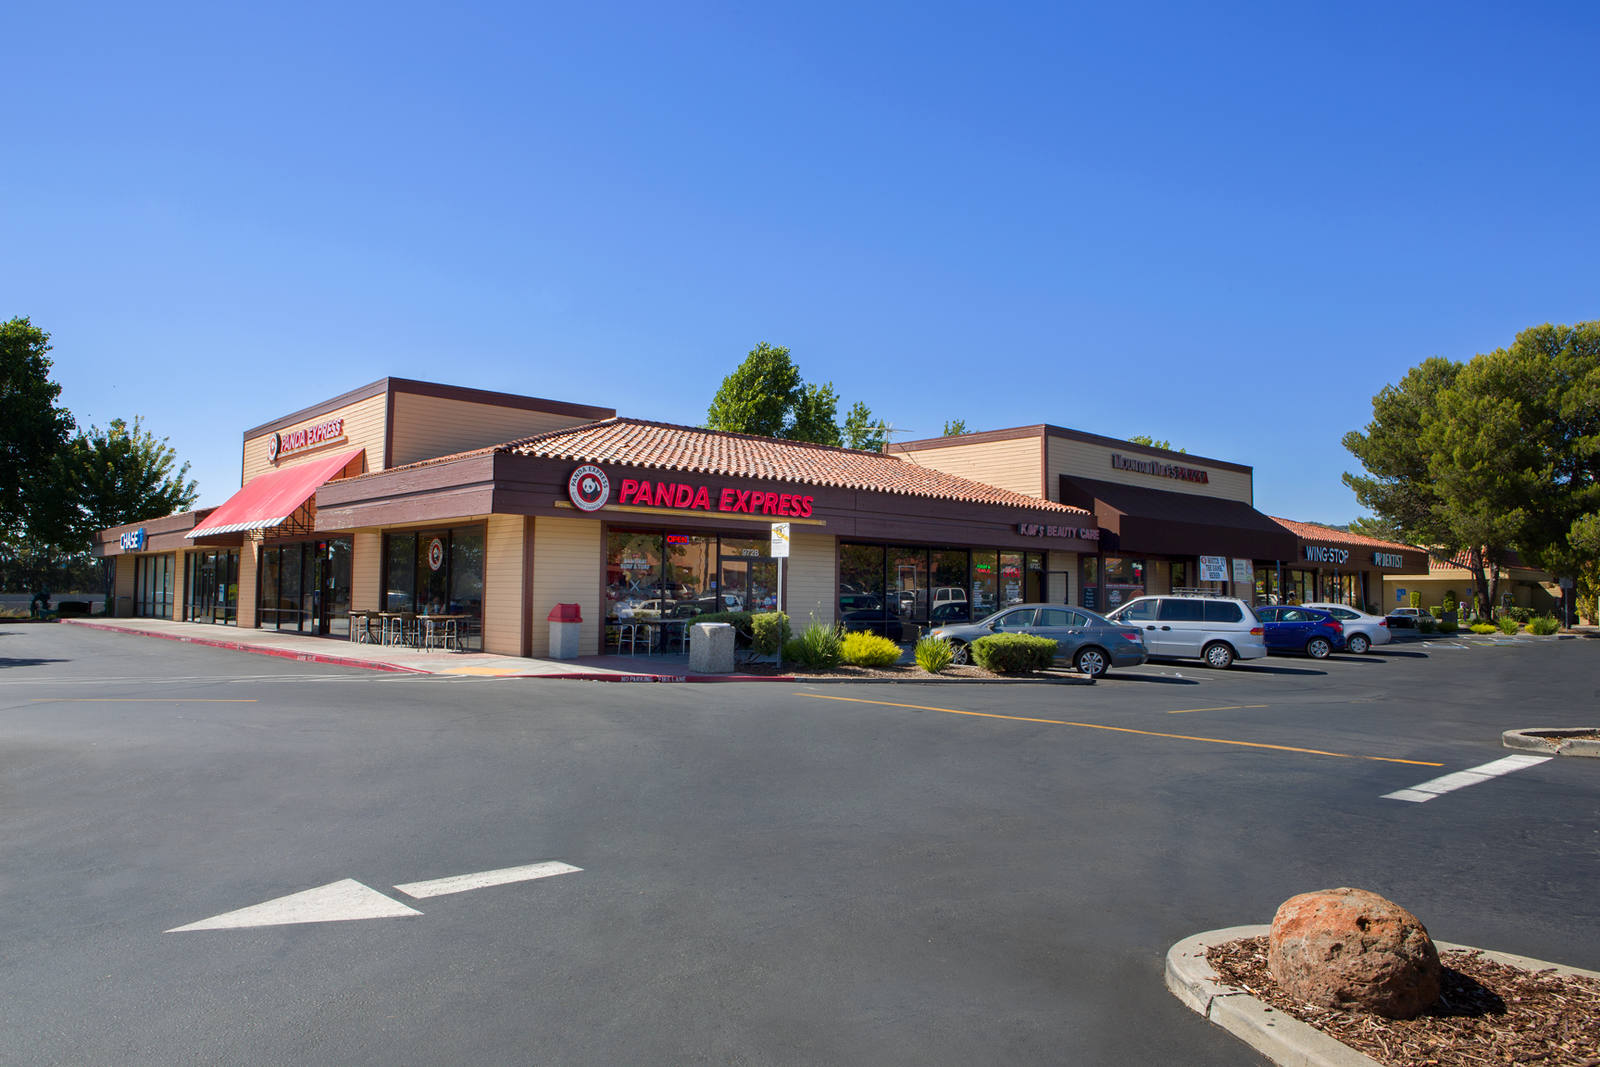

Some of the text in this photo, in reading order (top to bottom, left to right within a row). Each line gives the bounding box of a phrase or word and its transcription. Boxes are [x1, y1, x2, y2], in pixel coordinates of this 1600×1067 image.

[281, 419, 342, 452] PANDA EXPRESS
[571, 466, 608, 489] PANDA EXPRESS
[1178, 466, 1208, 484] PIZZA
[619, 479, 814, 518] PANDA EXPRESS
[120, 531, 138, 550] CHASE
[667, 535, 687, 543] OPEN
[1047, 525, 1077, 538] BEAUTY
[1080, 528, 1100, 540] CARE
[1382, 553, 1403, 568] DENTIST
